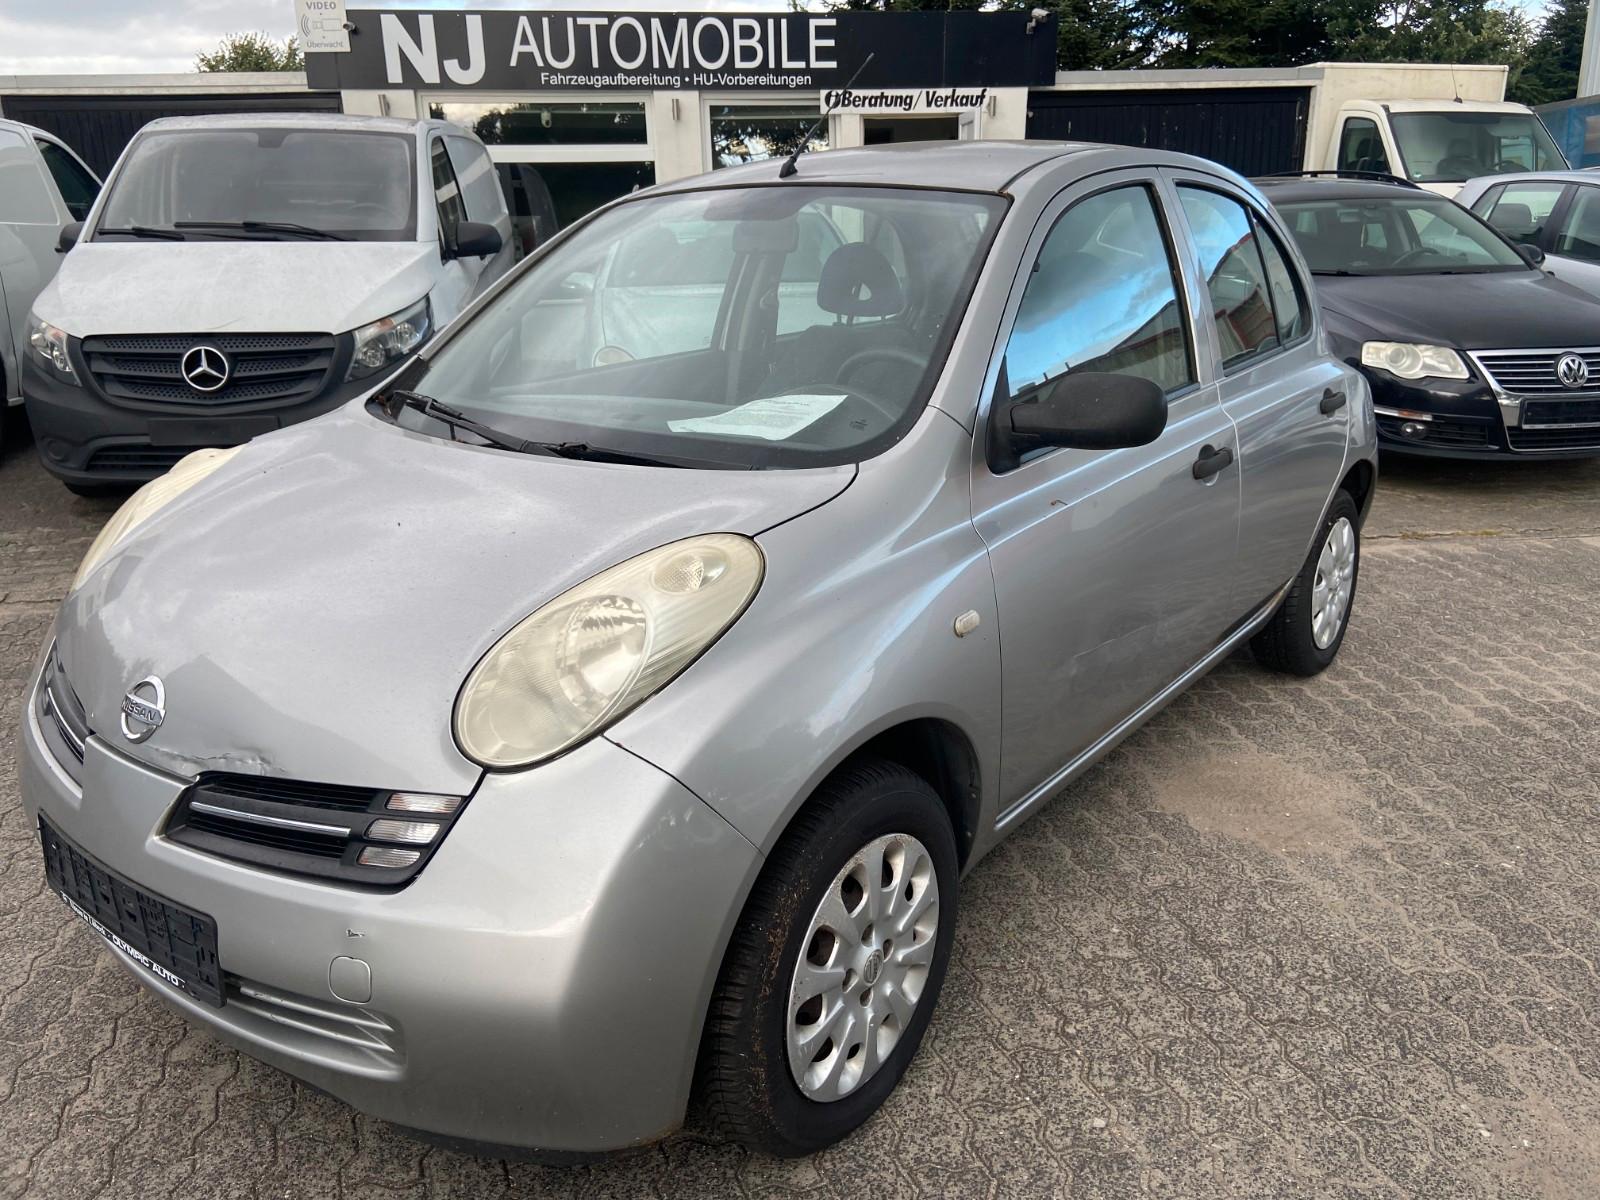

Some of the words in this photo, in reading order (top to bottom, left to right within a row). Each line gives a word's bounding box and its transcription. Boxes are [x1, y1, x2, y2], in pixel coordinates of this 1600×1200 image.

[306, 1, 336, 10] VIDEO
[380, 14, 486, 85] NJ
[510, 16, 838, 69] AUTOMOBILE
[541, 72, 681, 88] Fahrzeugaufbereitung
[693, 73, 812, 87] HU-Vorbereitungen
[122, 700, 157, 721] NISSAN
[112, 934, 150, 967] OLYMPIC
[152, 962, 179, 986] AUTO
